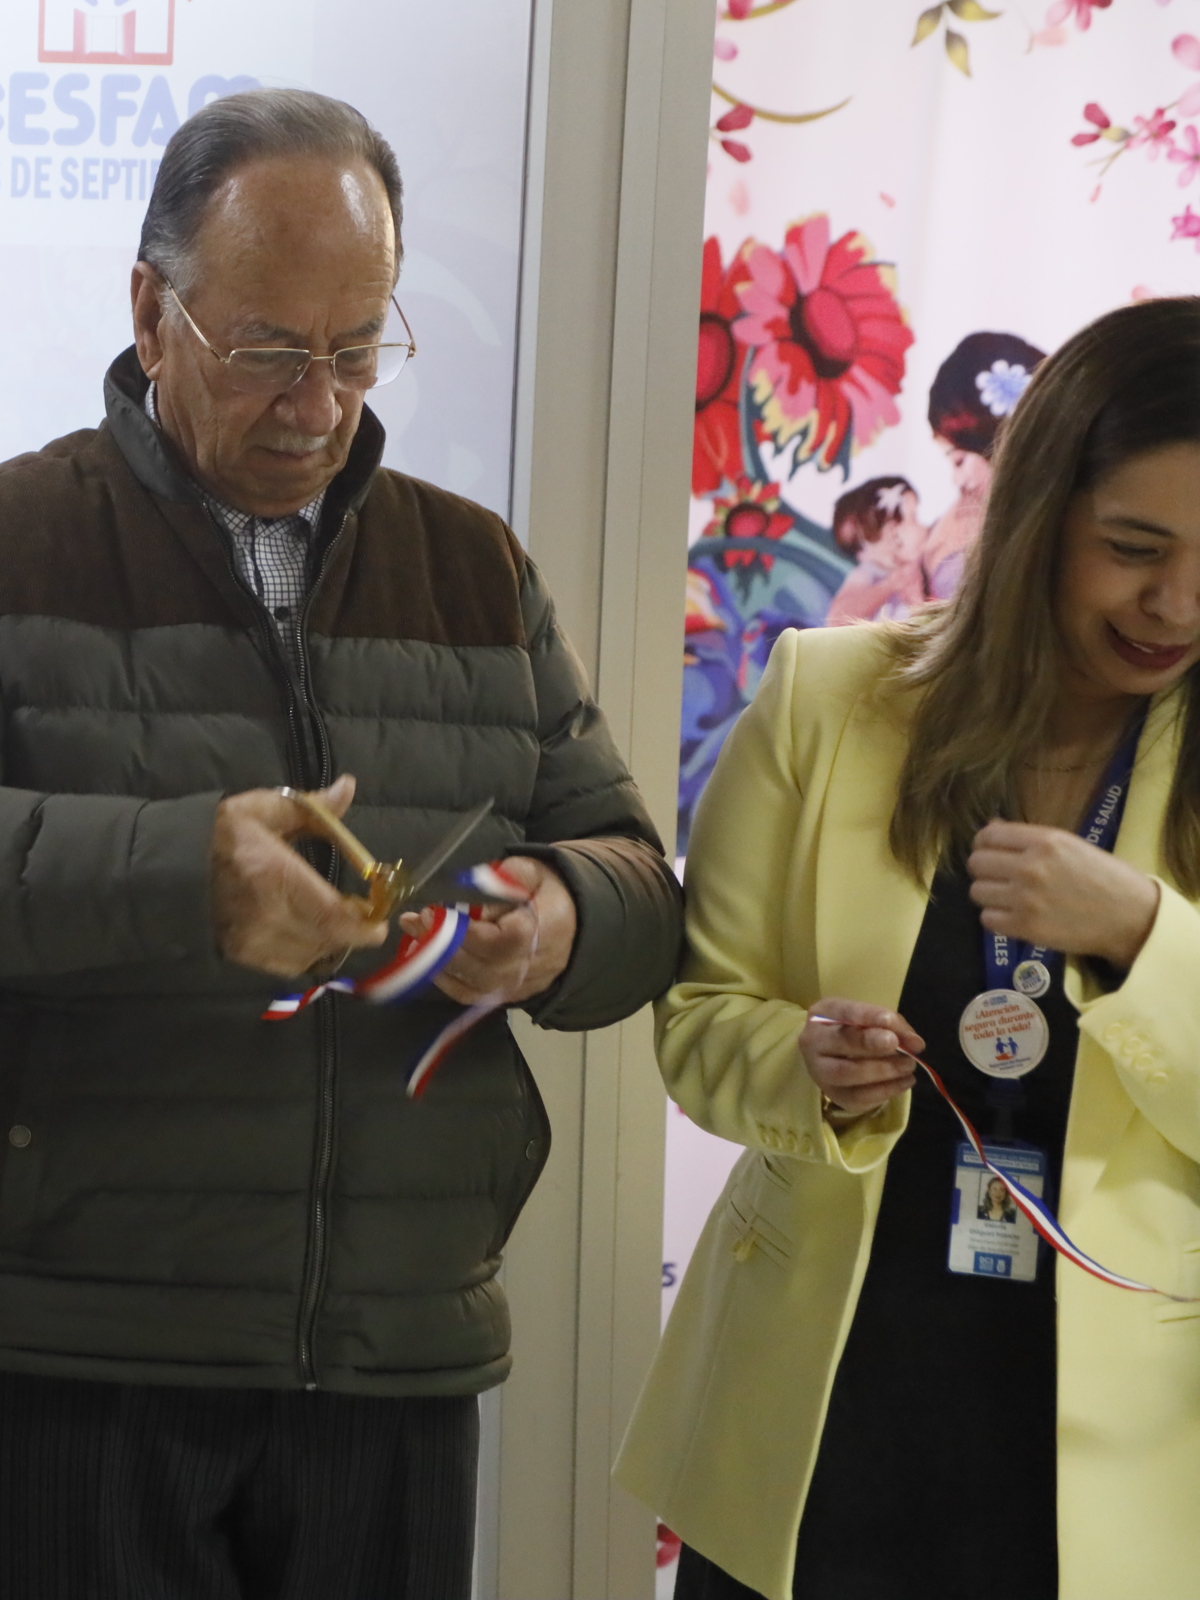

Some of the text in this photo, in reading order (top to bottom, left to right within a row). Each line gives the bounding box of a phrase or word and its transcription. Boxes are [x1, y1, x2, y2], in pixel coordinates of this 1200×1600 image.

[10, 155, 52, 199] DE
[1086, 785, 1122, 844] DE SALUD
[994, 934, 1009, 966] ELES
[964, 1011, 1036, 1033] segura durante
[973, 1029, 995, 1040] toda
[996, 1027, 1006, 1036] la
